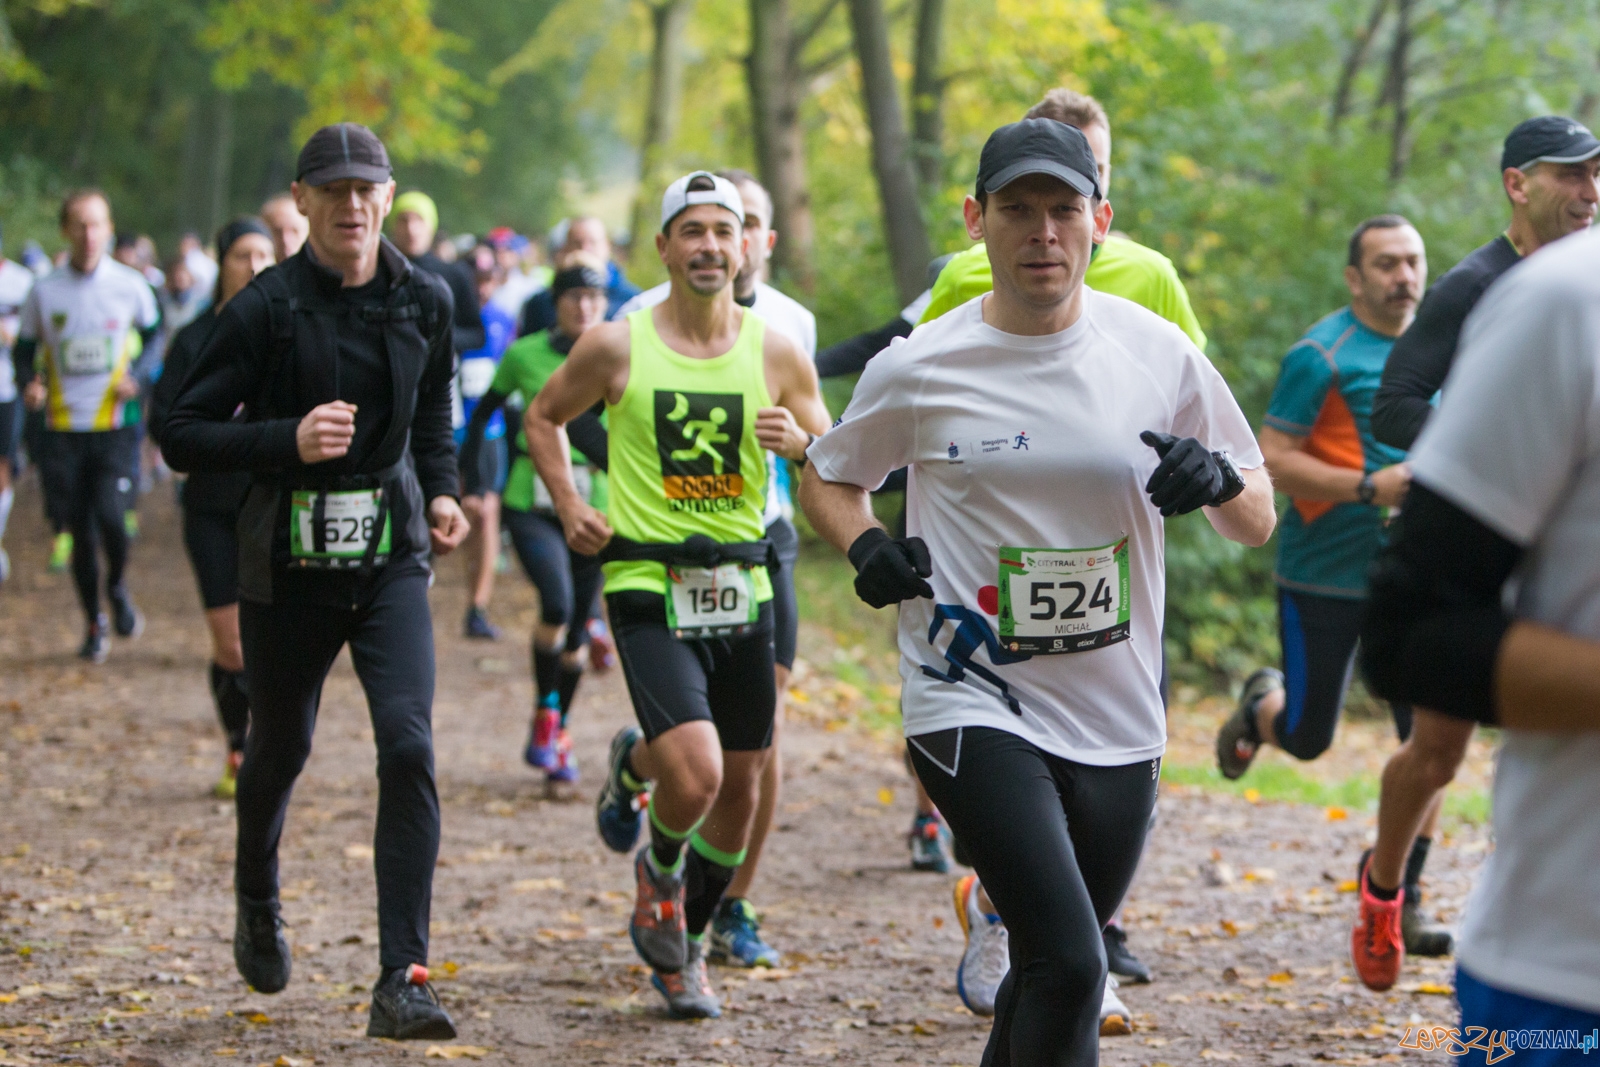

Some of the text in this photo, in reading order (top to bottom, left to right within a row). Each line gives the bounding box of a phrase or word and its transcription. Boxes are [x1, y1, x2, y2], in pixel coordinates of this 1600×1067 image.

[308, 516, 375, 543] 628
[687, 587, 738, 614] 150
[1030, 577, 1112, 620] 524
[1054, 622, 1092, 634] MICHAŁ
